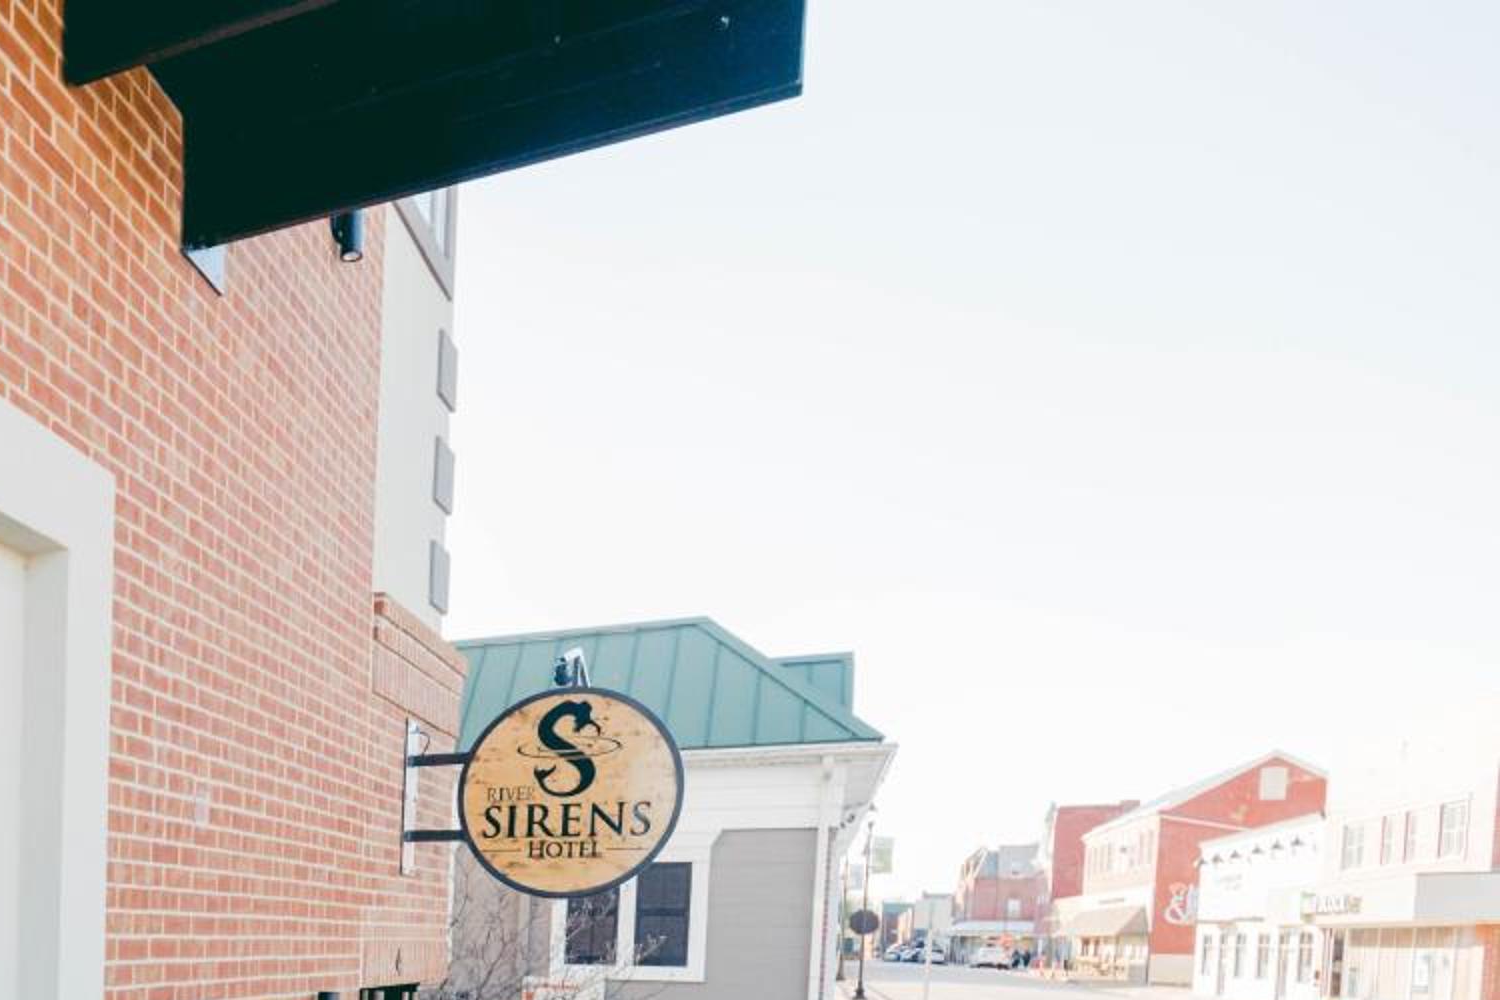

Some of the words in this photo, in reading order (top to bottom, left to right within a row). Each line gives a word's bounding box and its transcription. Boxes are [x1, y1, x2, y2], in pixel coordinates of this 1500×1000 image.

[487, 786, 535, 801] RIVER
[482, 801, 652, 839] SIRENS
[528, 839, 603, 859] HOTEL
